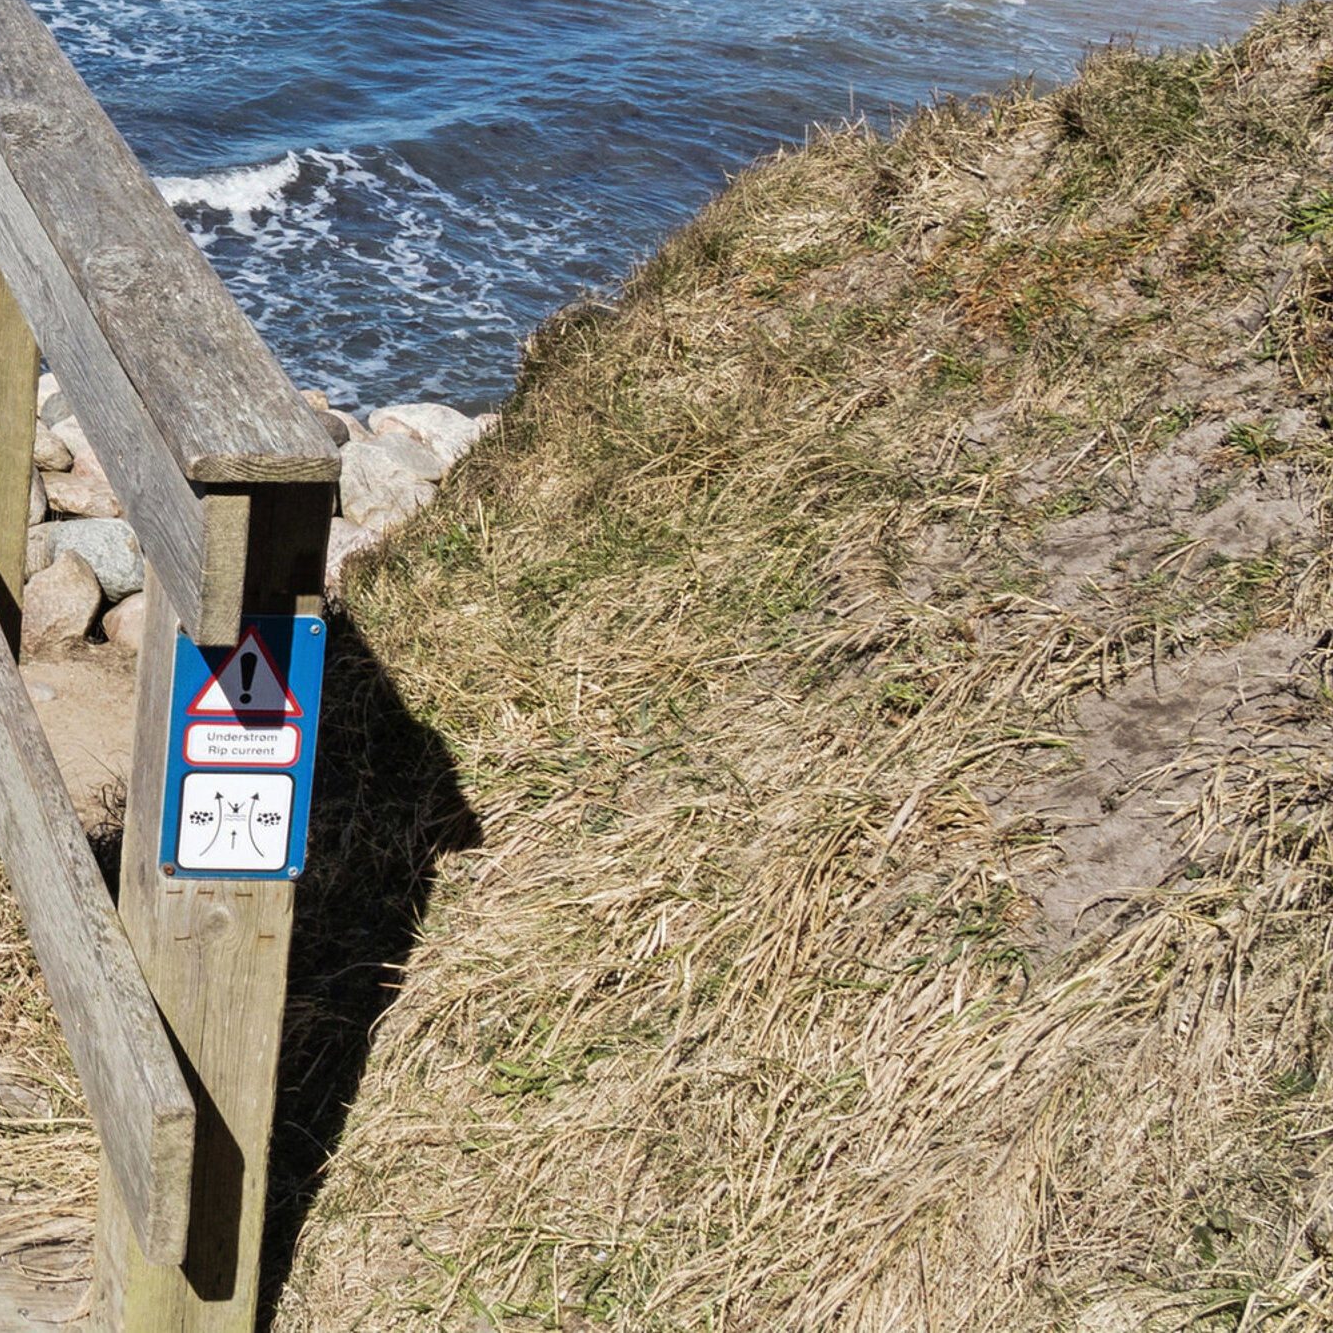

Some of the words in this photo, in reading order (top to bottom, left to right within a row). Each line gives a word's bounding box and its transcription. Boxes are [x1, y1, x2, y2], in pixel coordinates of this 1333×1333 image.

[207, 732, 278, 742] Understrøm
[208, 745, 228, 756] Rip
[231, 747, 275, 755] current
